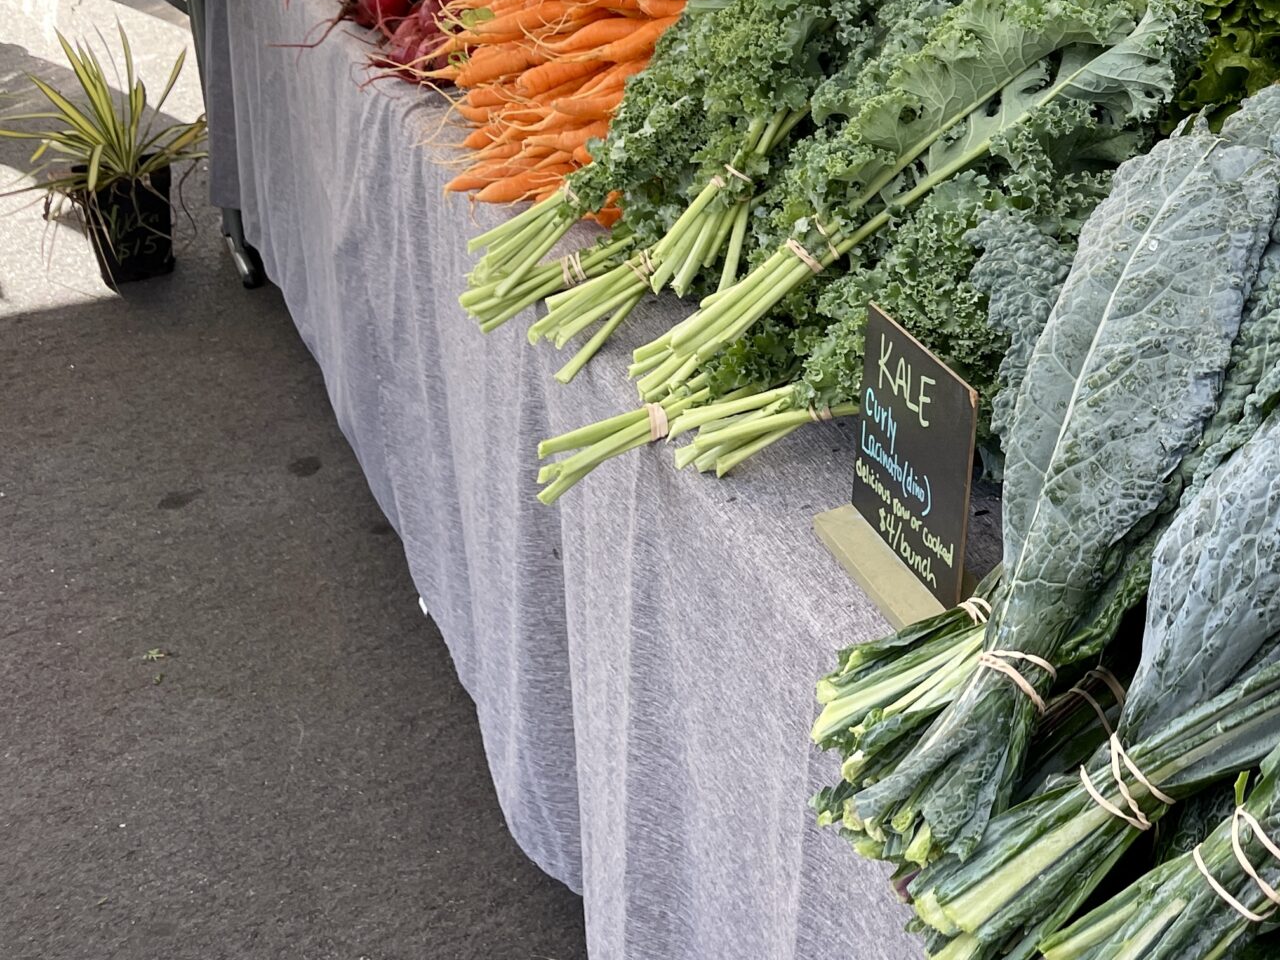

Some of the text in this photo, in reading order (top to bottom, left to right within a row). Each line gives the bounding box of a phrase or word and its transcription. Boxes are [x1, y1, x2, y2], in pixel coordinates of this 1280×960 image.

[865, 387, 897, 455] Curly
[878, 333, 937, 428] KALE
[855, 456, 955, 569] delicious raw or cooked
